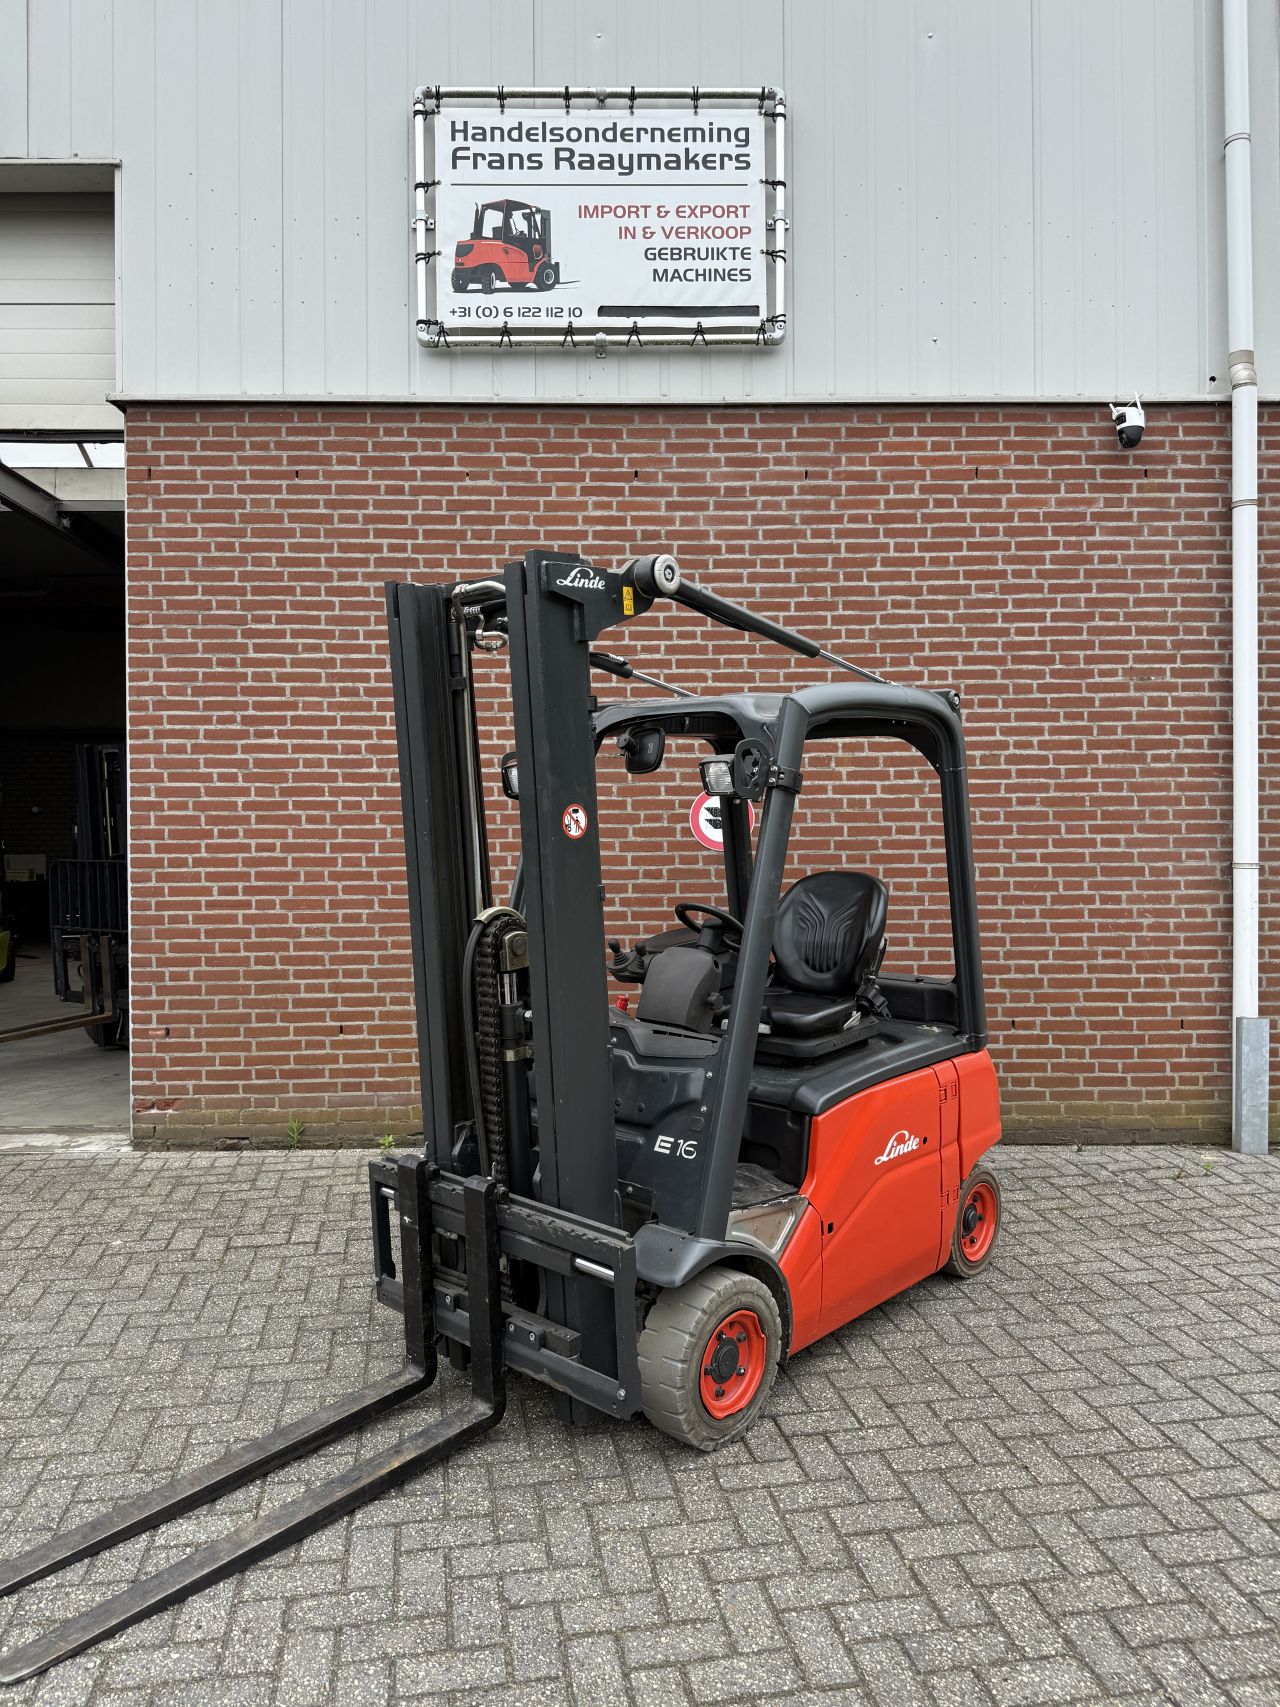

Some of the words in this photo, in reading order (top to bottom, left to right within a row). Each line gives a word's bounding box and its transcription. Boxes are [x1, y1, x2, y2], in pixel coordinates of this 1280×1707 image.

[450, 120, 750, 148] Handelsonderneming
[451, 147, 544, 171] Frans
[554, 147, 751, 177] Raaymakers
[578, 204, 652, 219] IMPORT
[656, 204, 671, 219] &
[675, 204, 751, 219] EXPORT
[618, 225, 637, 240] IN
[641, 225, 657, 240] &
[660, 225, 752, 240] VERKOOP
[643, 246, 752, 261] GEBRUIKTE
[652, 267, 752, 283] MACHINES
[449, 306, 471, 318] +31
[475, 305, 499, 319] (0)
[503, 306, 514, 318] 6
[517, 306, 542, 318] 122
[545, 306, 564, 318] 112
[568, 306, 583, 318] 10
[556, 567, 606, 590] Linde
[874, 1130, 920, 1165] Linde
